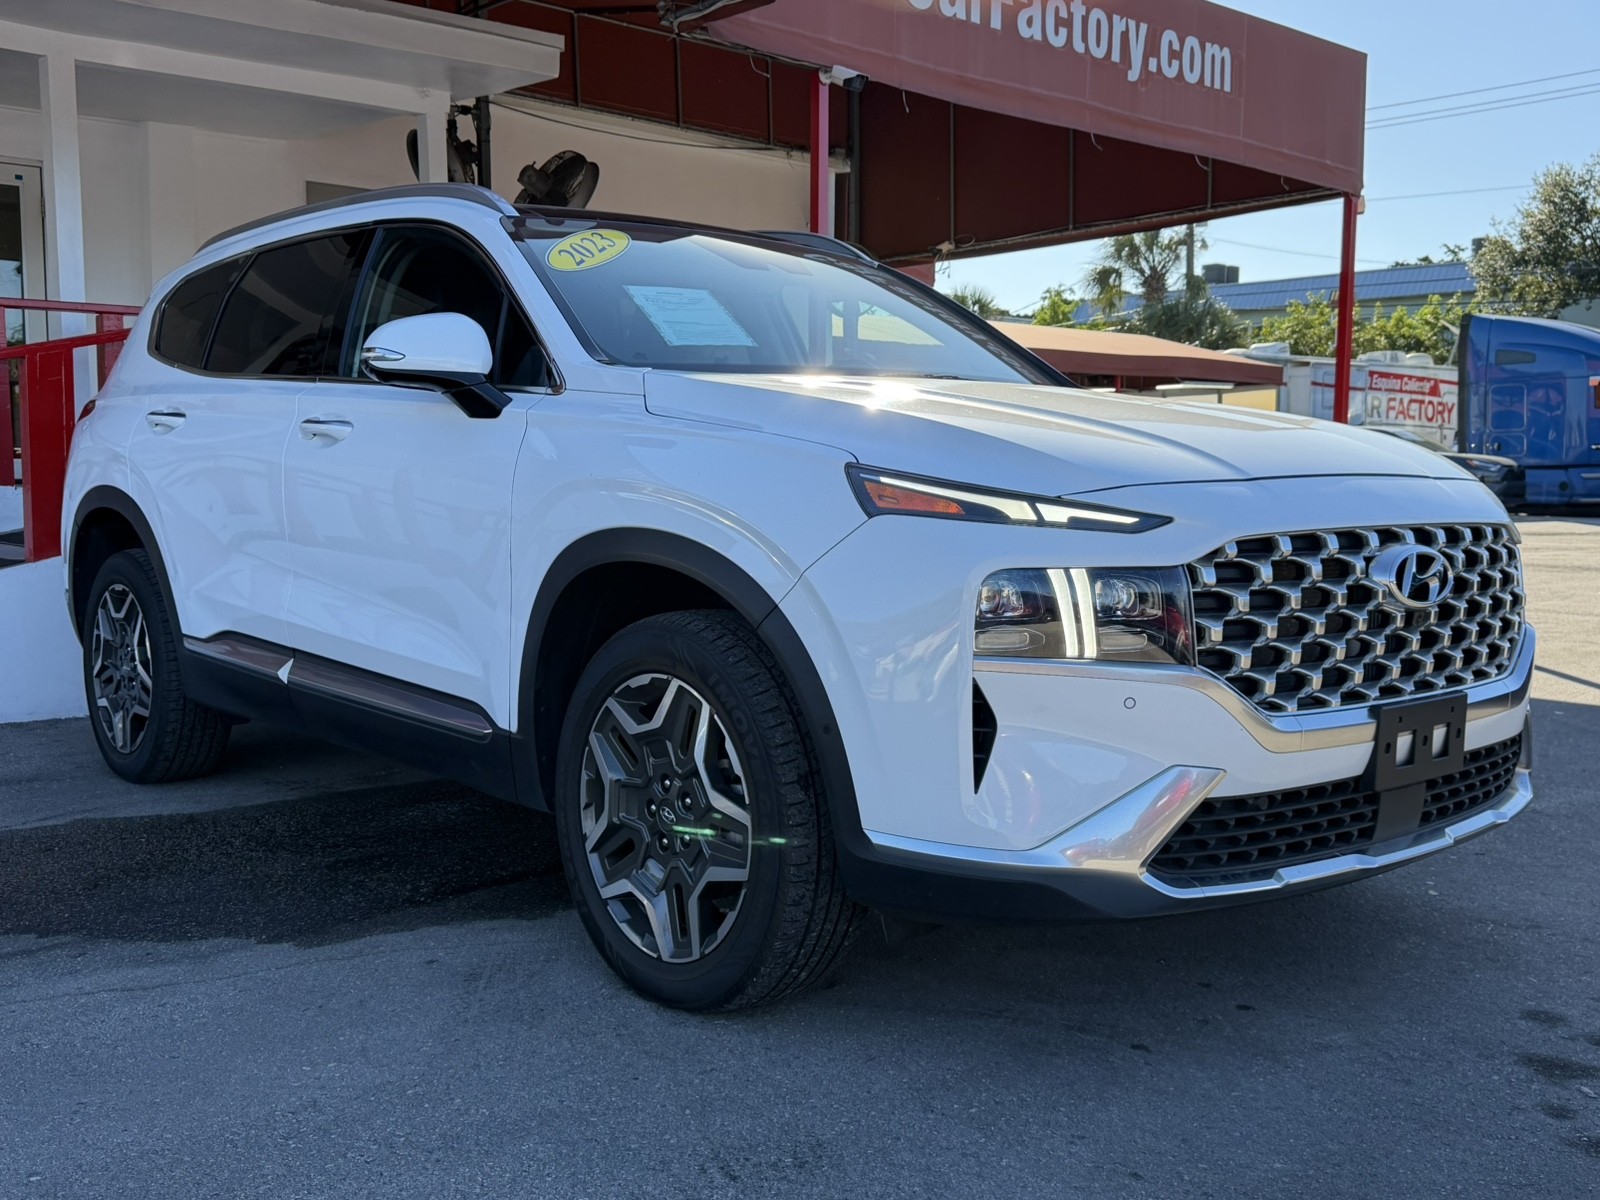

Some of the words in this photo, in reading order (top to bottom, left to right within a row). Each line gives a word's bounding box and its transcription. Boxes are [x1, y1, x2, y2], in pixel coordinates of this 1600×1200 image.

[907, 0, 1231, 93] actory.com
[558, 231, 616, 267] 2023
[1386, 397, 1455, 424] FACTORY
